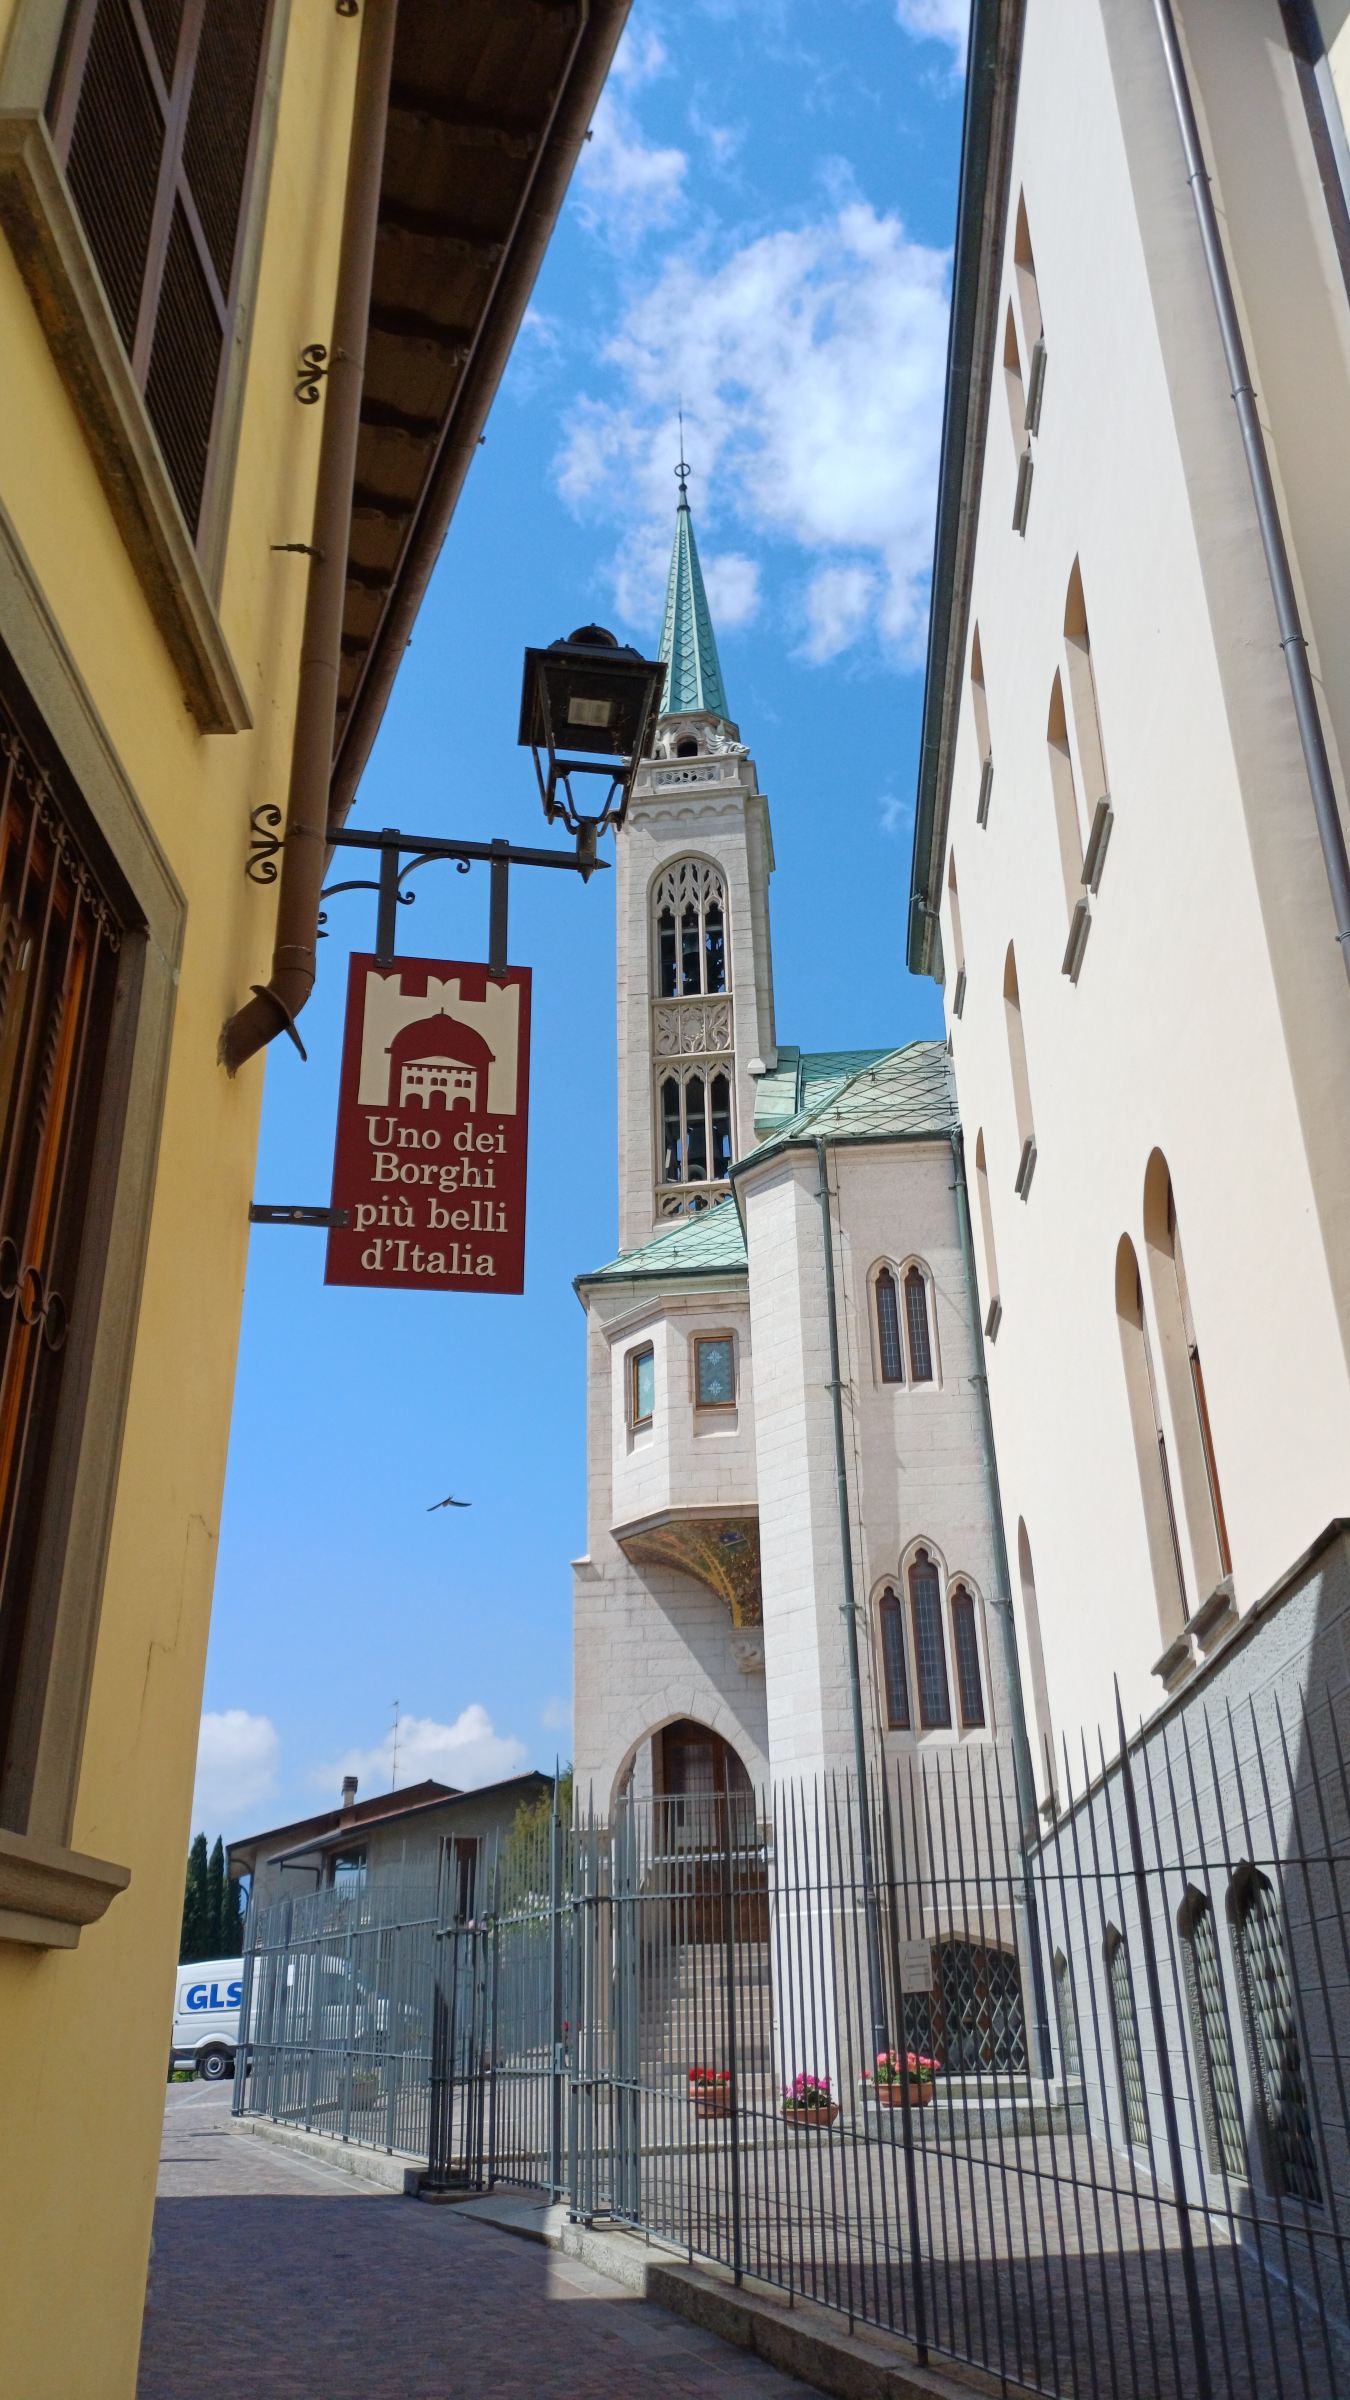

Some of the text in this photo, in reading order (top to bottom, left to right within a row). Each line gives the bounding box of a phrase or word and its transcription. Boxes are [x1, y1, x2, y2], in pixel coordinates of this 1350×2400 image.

[365, 1116, 507, 1153] Uno dei
[370, 1152, 496, 1193] Borghi
[353, 1195, 508, 1233] più belli
[361, 1238, 496, 1277] d'Italia
[186, 1982, 243, 2010] GLS
